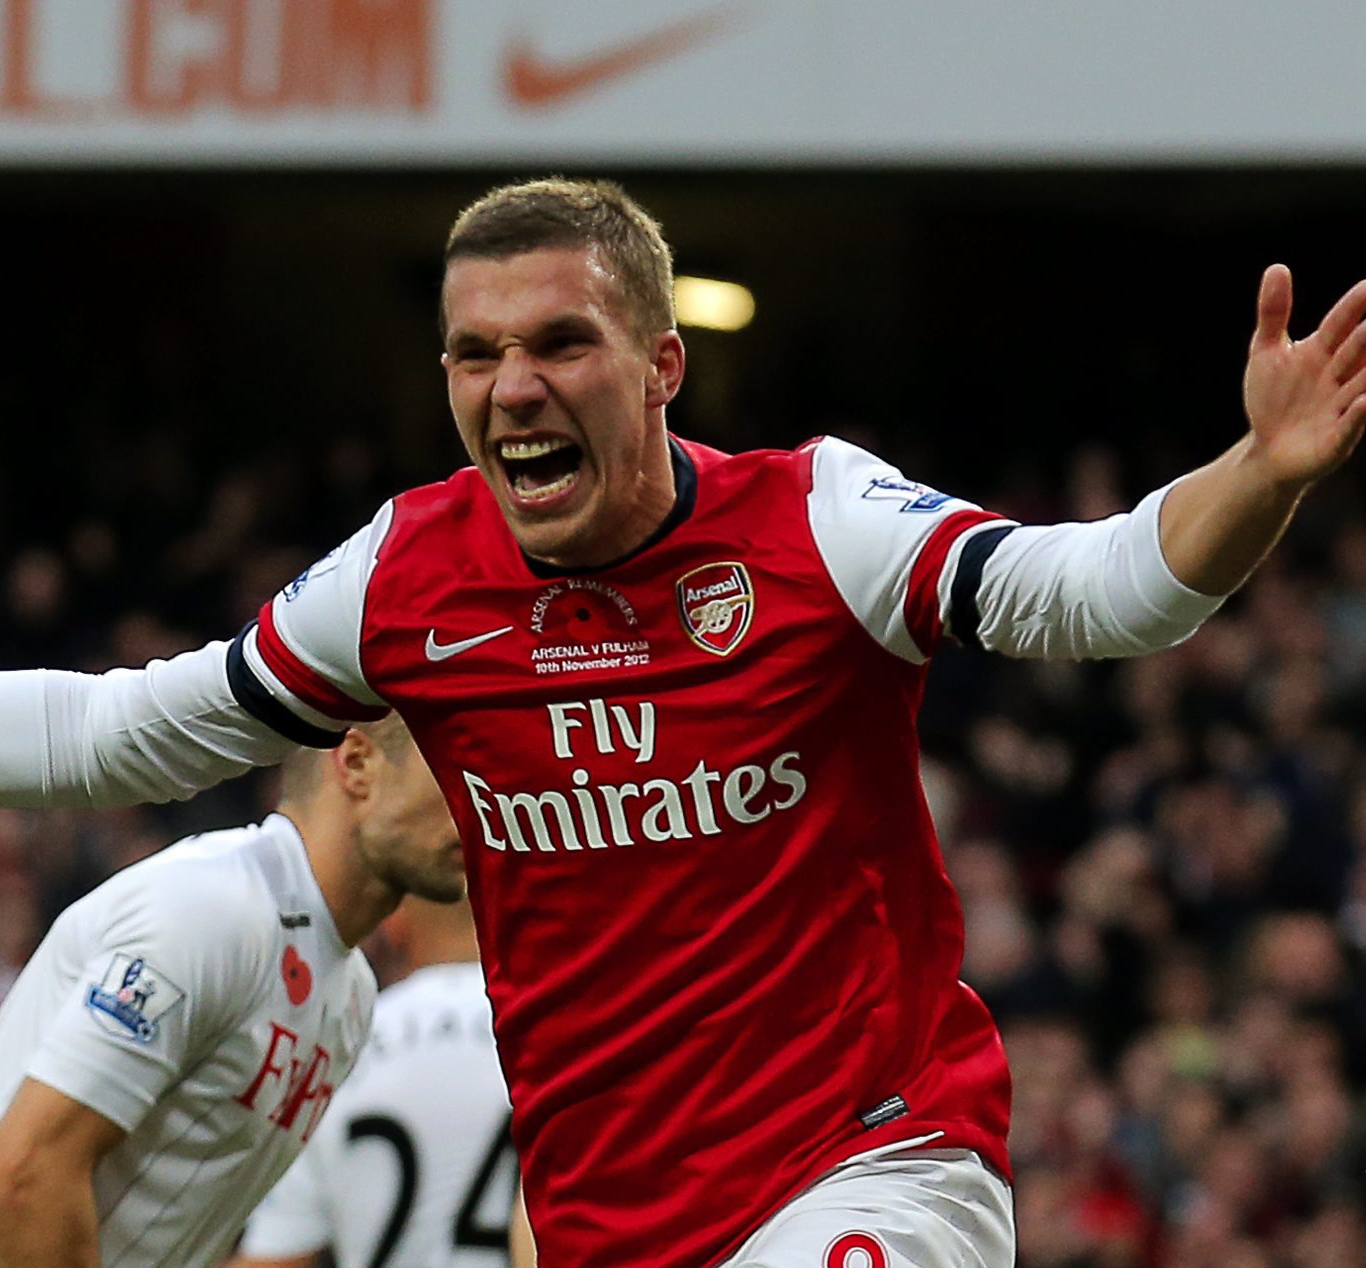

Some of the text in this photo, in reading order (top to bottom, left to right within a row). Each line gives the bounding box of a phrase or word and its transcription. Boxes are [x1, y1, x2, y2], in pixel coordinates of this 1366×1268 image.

[686, 575, 739, 603] Arsenal
[531, 645, 590, 661] ARSENAL
[601, 640, 650, 656] FULHAM
[535, 654, 651, 675] 10th November 2012
[547, 698, 657, 763] Fly
[462, 750, 808, 853] Emirates
